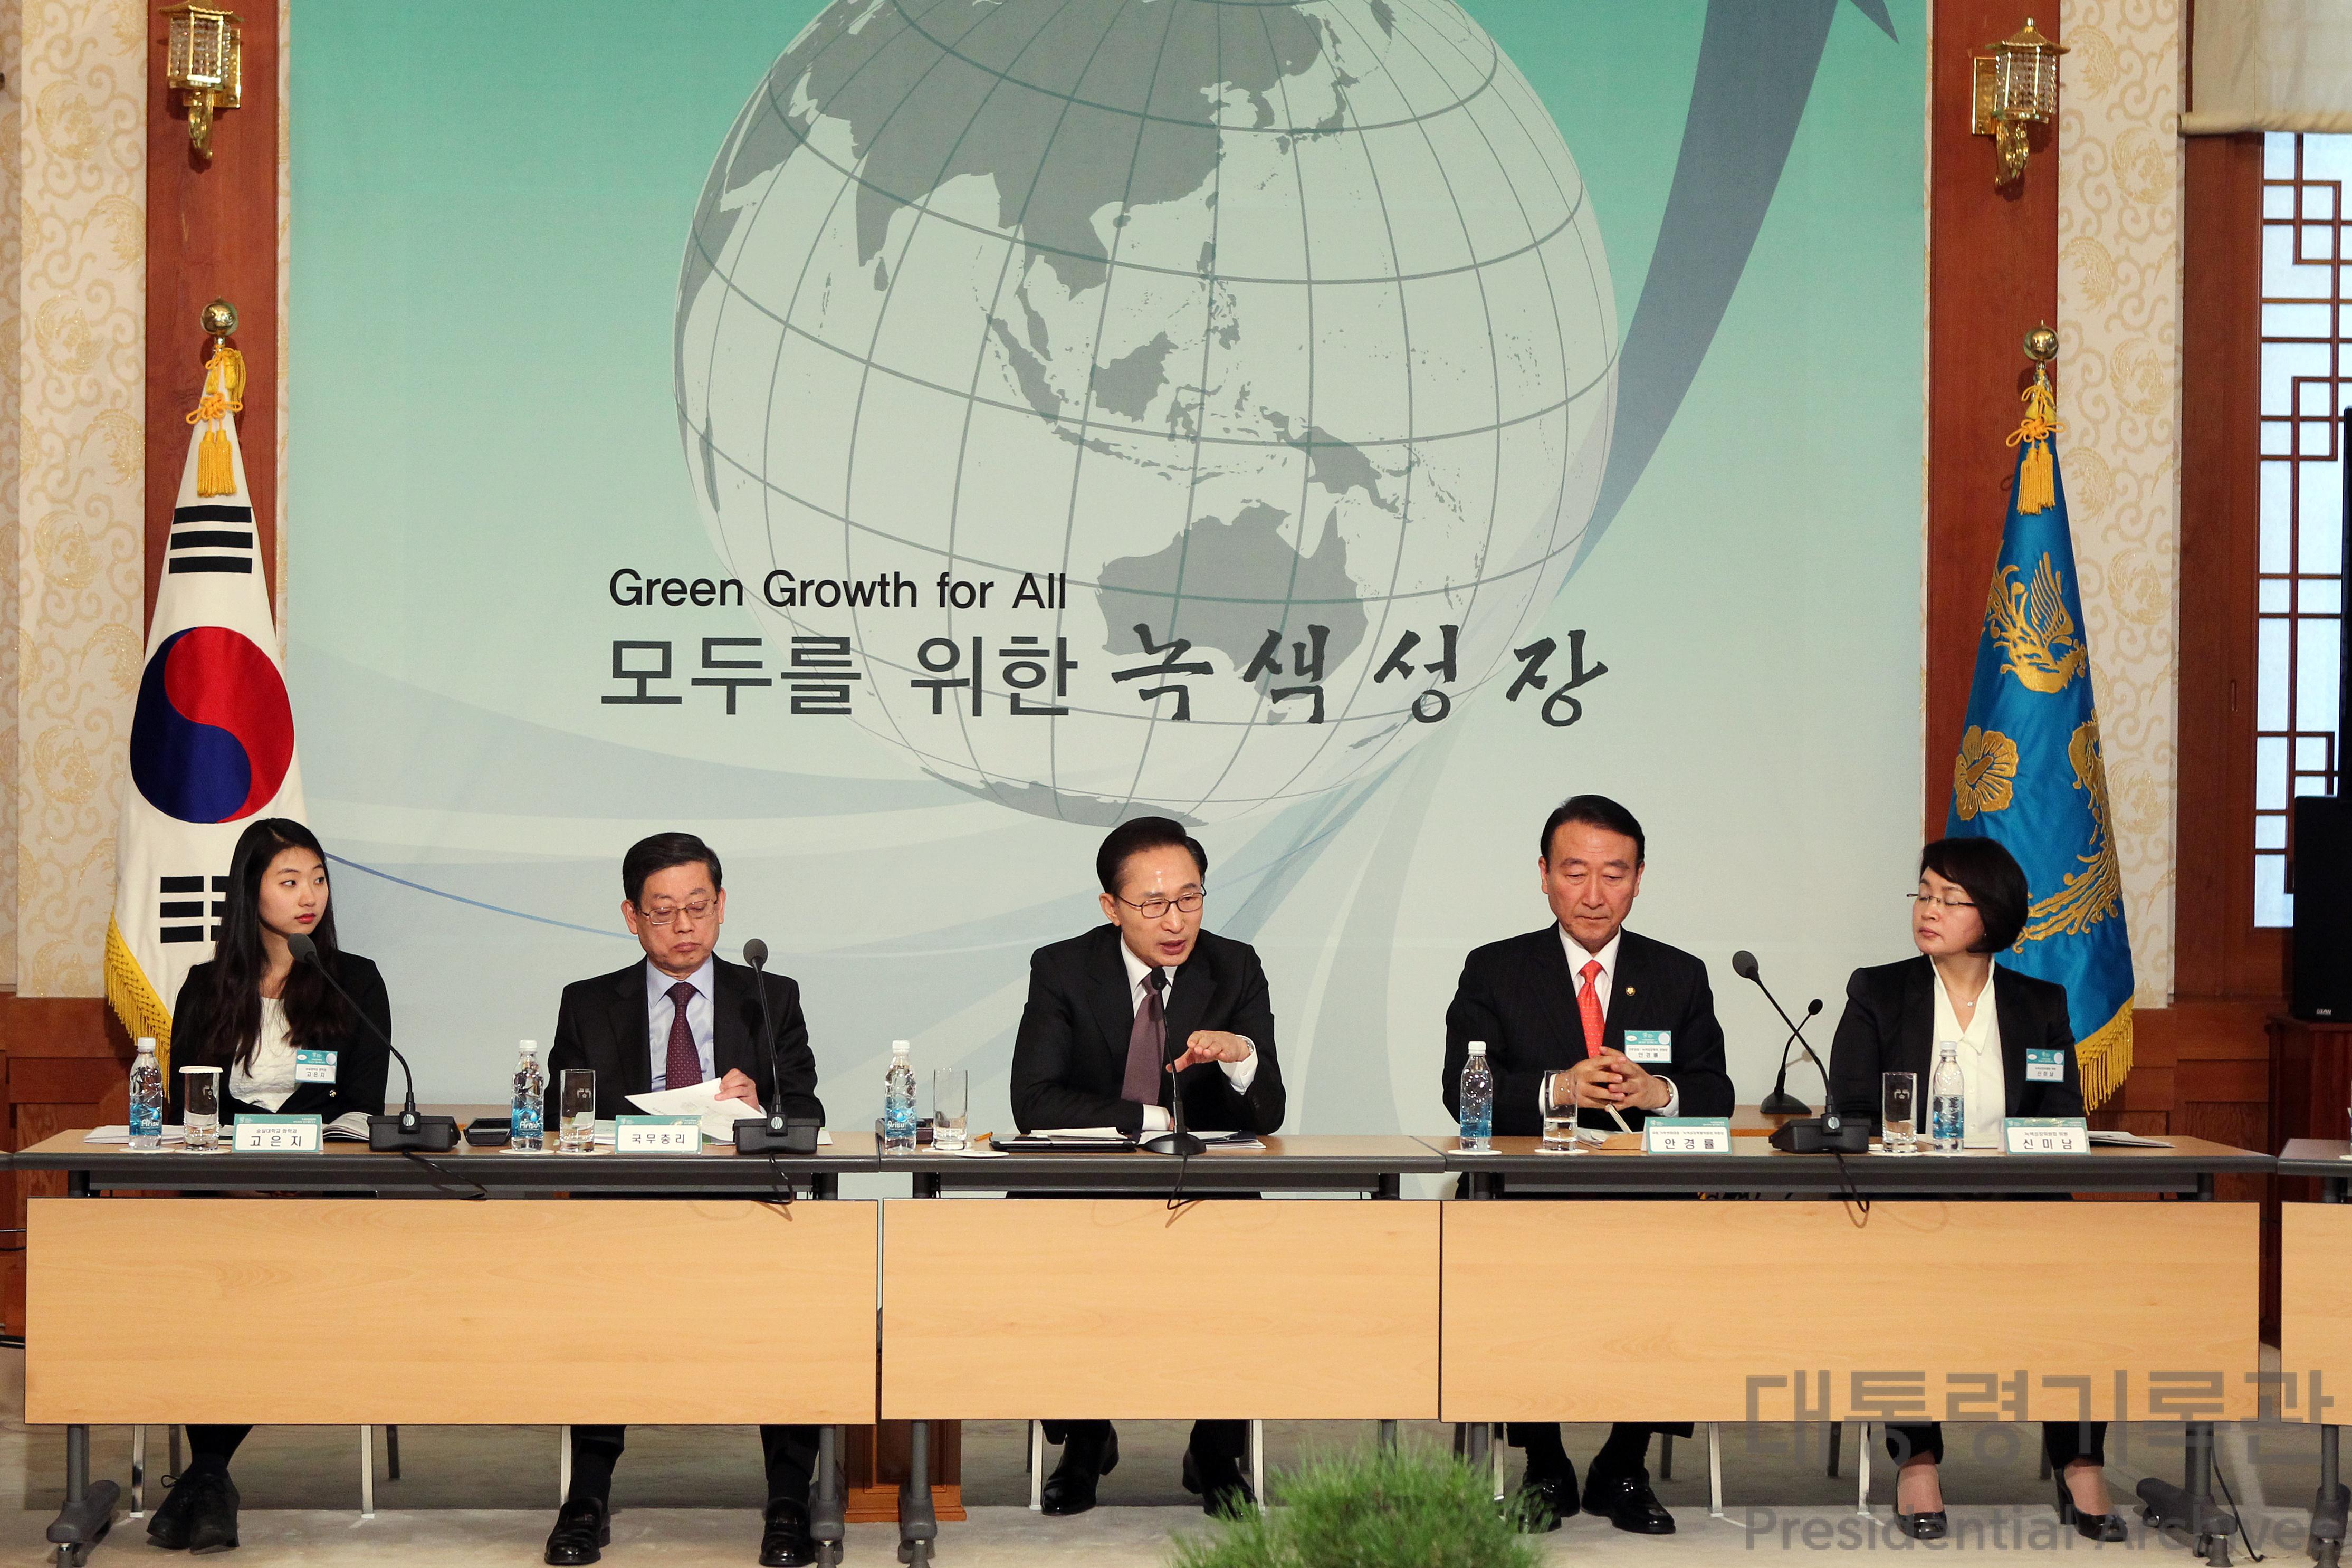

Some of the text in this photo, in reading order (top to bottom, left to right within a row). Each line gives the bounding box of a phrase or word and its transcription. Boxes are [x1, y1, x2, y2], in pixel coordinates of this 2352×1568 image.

[610, 568, 1066, 609] Green Growth for All
[601, 636, 862, 715] 모두를
[911, 636, 1078, 716] 위한
[887, 1120, 905, 1129] Arisu
